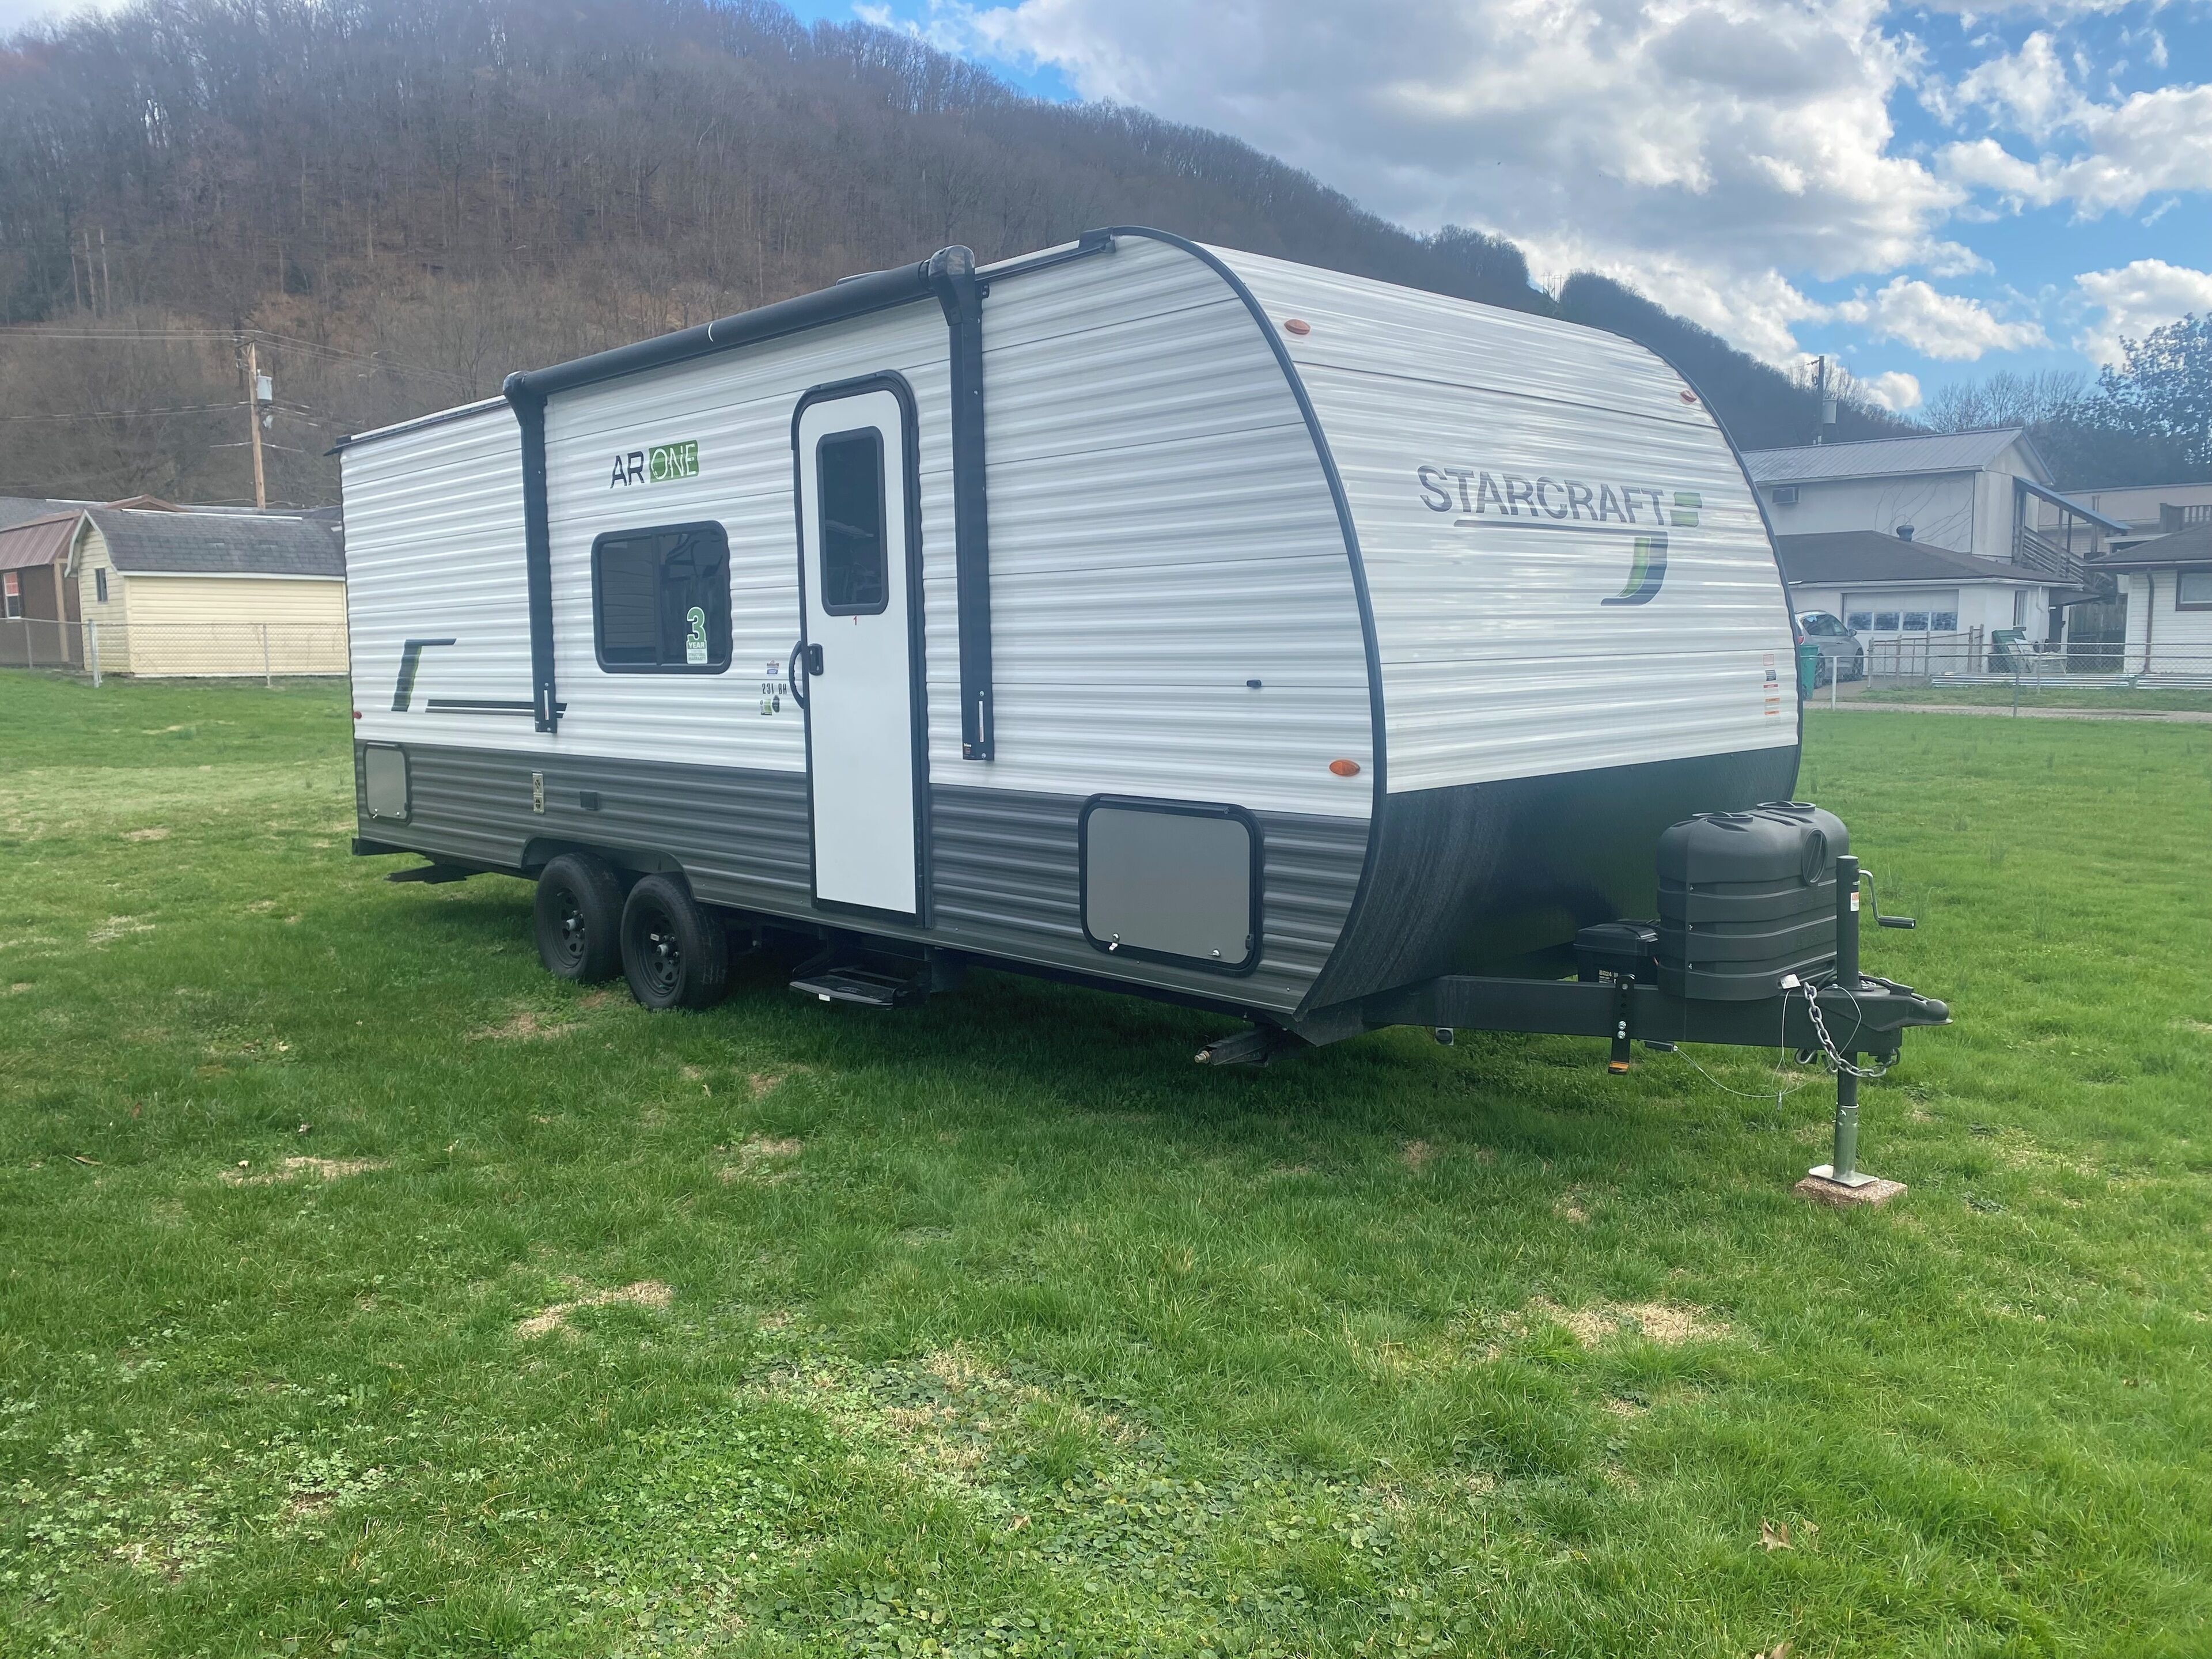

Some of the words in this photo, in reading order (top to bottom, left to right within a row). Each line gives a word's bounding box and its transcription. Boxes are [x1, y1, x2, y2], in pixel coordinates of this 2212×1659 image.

[610, 451, 645, 488] AR
[651, 444, 696, 479] ONE
[1417, 465, 1664, 525] STARCRAFT
[687, 607, 706, 642] 3
[762, 683, 774, 695] 231
[778, 683, 787, 695] BH
